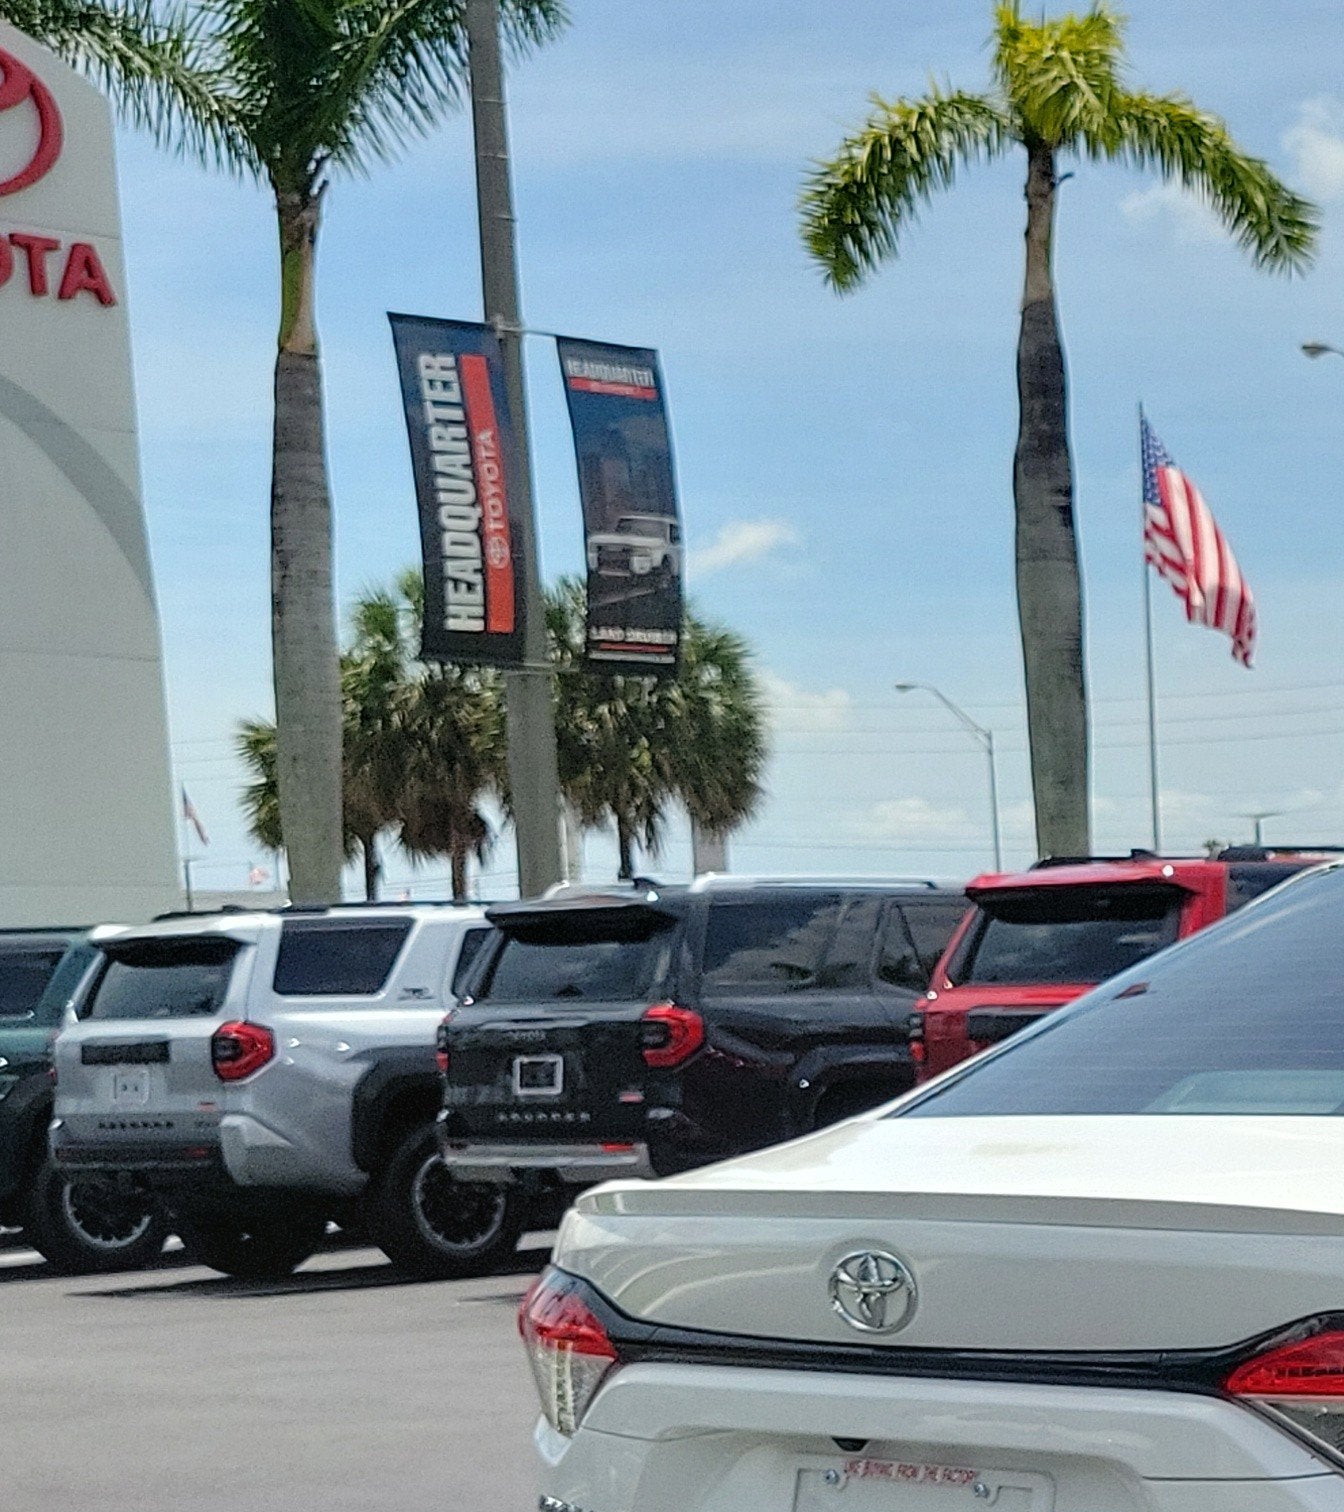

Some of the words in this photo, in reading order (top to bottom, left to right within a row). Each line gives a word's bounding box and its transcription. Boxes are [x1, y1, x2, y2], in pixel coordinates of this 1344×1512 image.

[0, 233, 118, 308] TA
[418, 352, 486, 633] HEADQUARTER
[477, 429, 506, 530] TOYOTA
